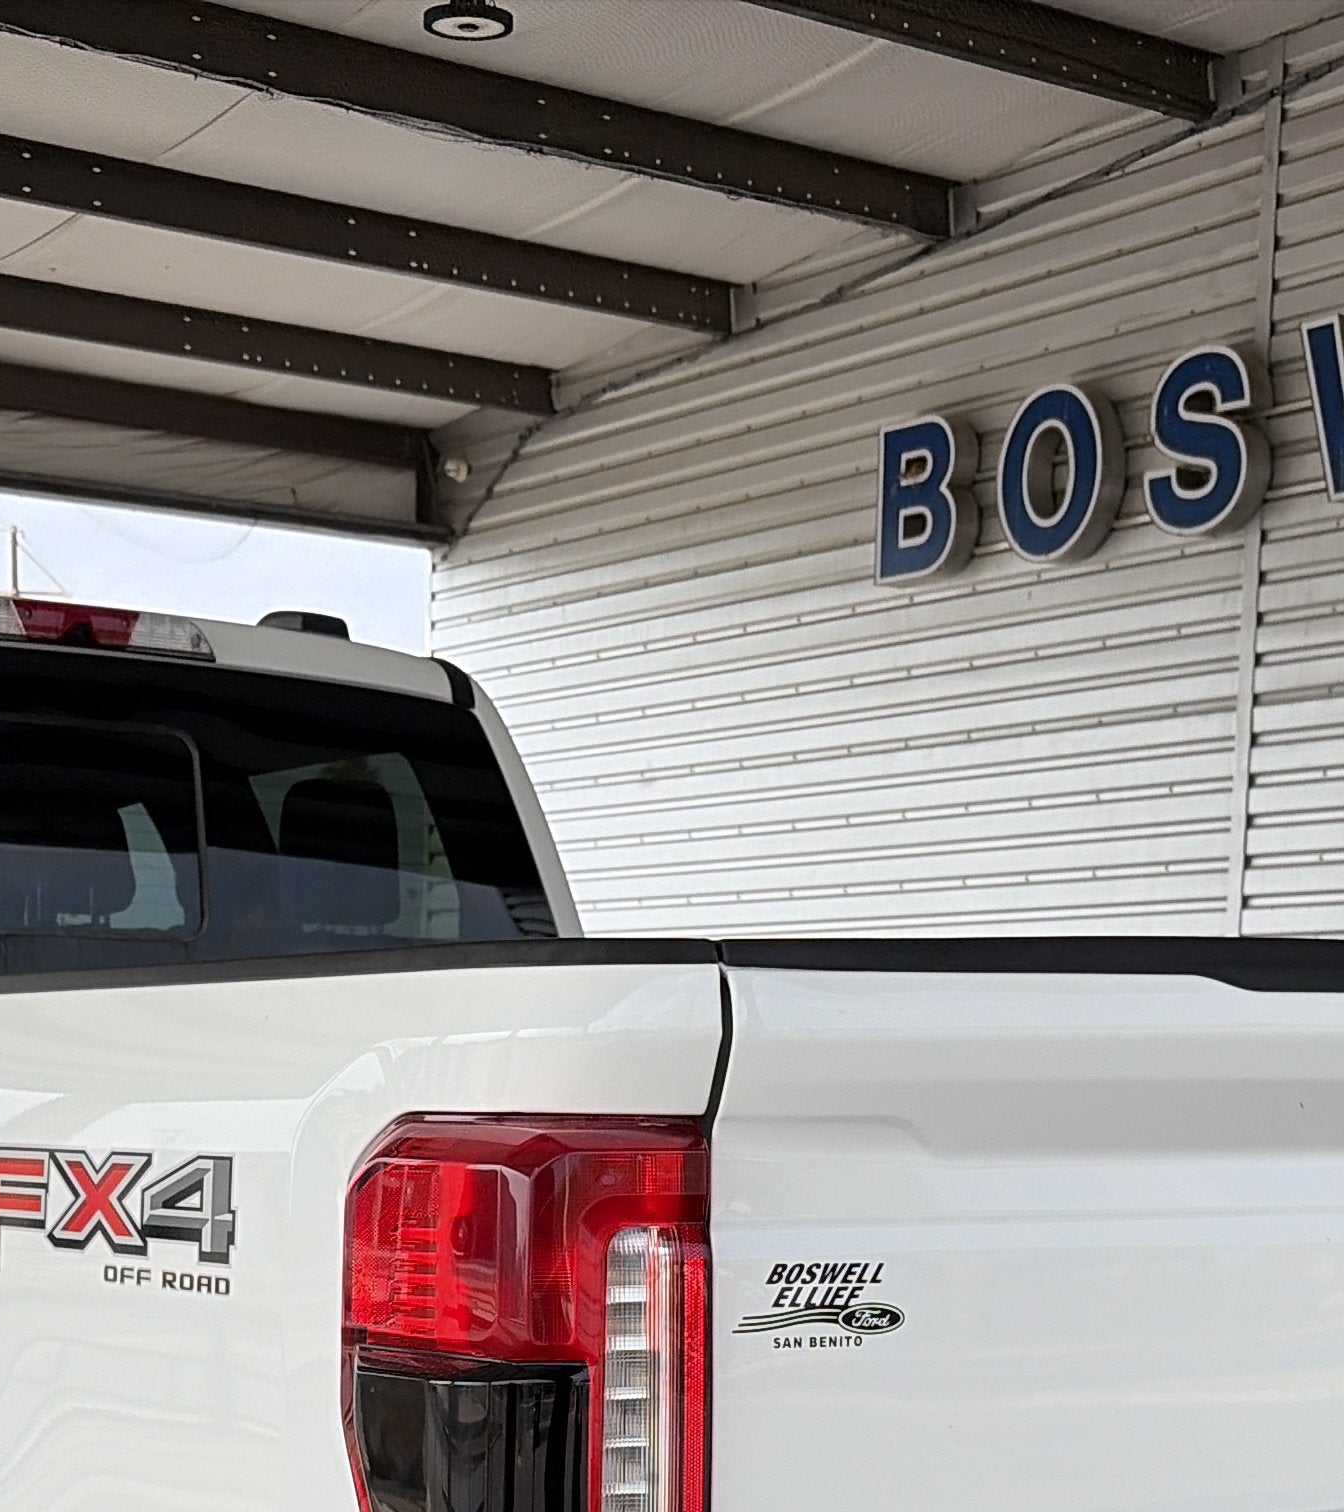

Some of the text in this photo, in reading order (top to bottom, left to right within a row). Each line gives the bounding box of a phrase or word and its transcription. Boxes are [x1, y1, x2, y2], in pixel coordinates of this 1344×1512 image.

[103, 1265, 231, 1296] OFF ROAD
[765, 1262, 885, 1285] BOSWELL
[771, 1286, 865, 1308] ELLIFF
[851, 1308, 892, 1328] Ford
[772, 1335, 864, 1349] SAN BENITO
